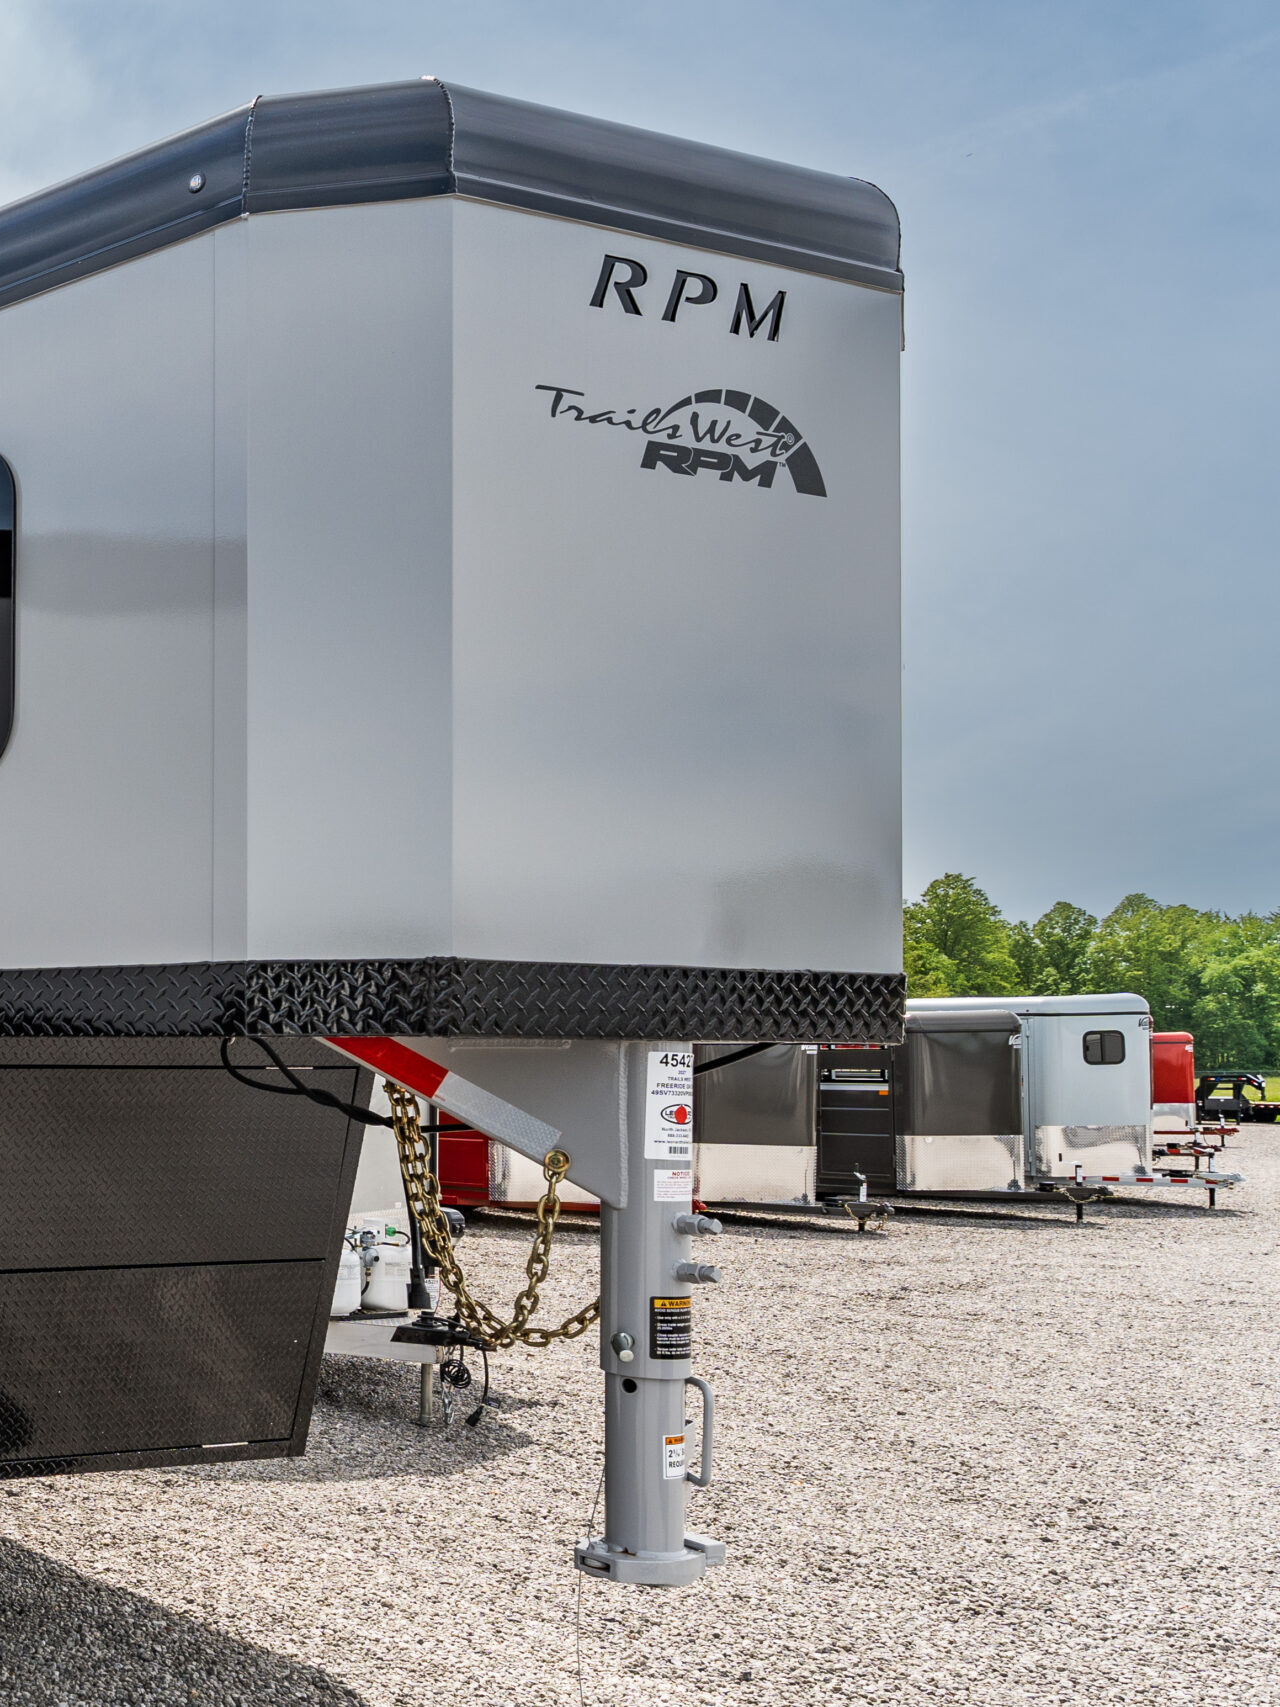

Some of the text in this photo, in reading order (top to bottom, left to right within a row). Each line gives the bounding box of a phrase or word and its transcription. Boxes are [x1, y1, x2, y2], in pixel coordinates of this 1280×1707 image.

[589, 254, 787, 342] RPM
[535, 384, 787, 457] Trails West
[640, 440, 779, 489] RPM
[659, 1053, 694, 1068] 4542
